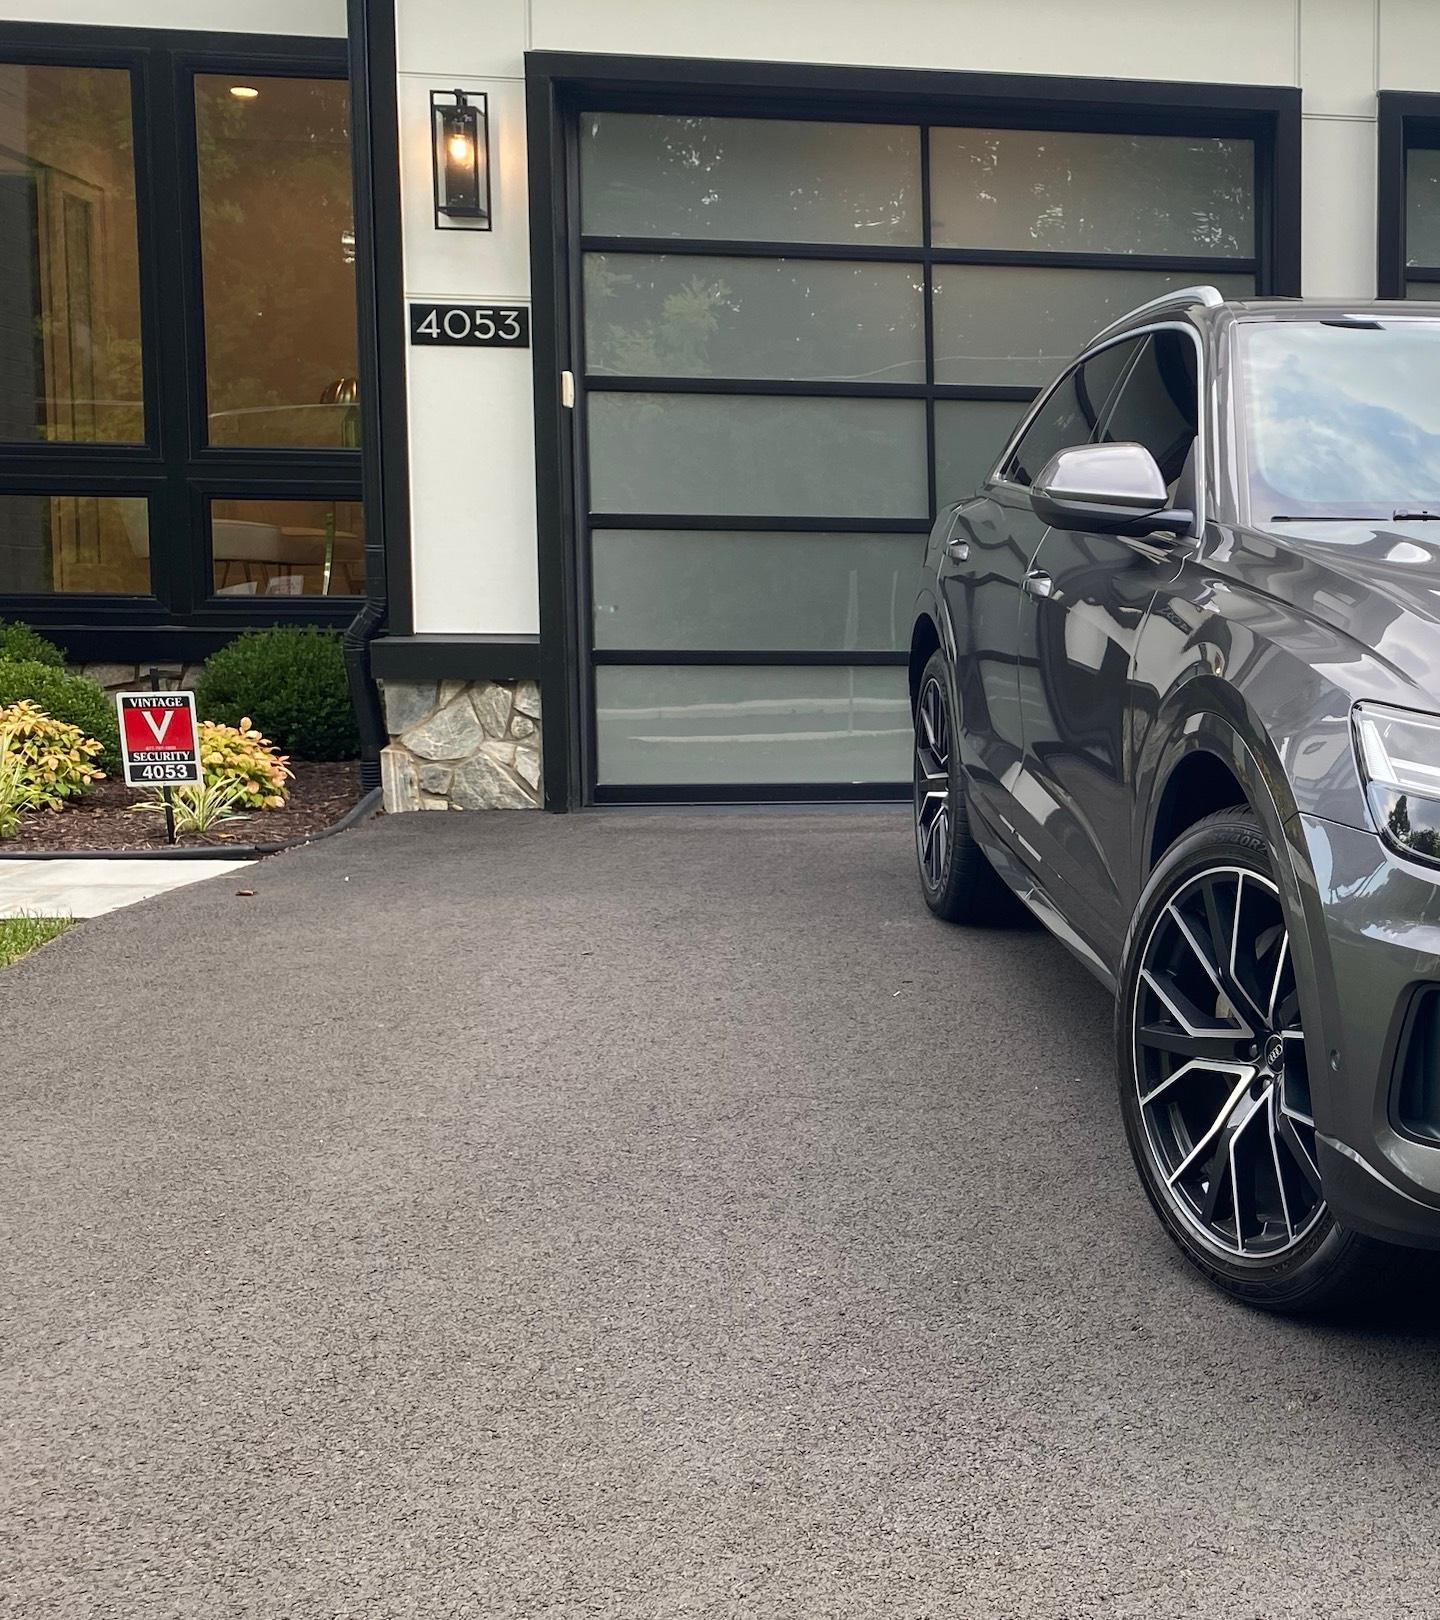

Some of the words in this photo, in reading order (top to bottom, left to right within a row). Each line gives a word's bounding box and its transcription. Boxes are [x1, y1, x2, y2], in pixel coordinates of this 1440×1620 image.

[415, 308, 521, 340] 4053
[129, 697, 184, 708] VINTAGE
[141, 710, 175, 745] V
[133, 751, 190, 762] SECURITY
[142, 764, 188, 779] 4053
